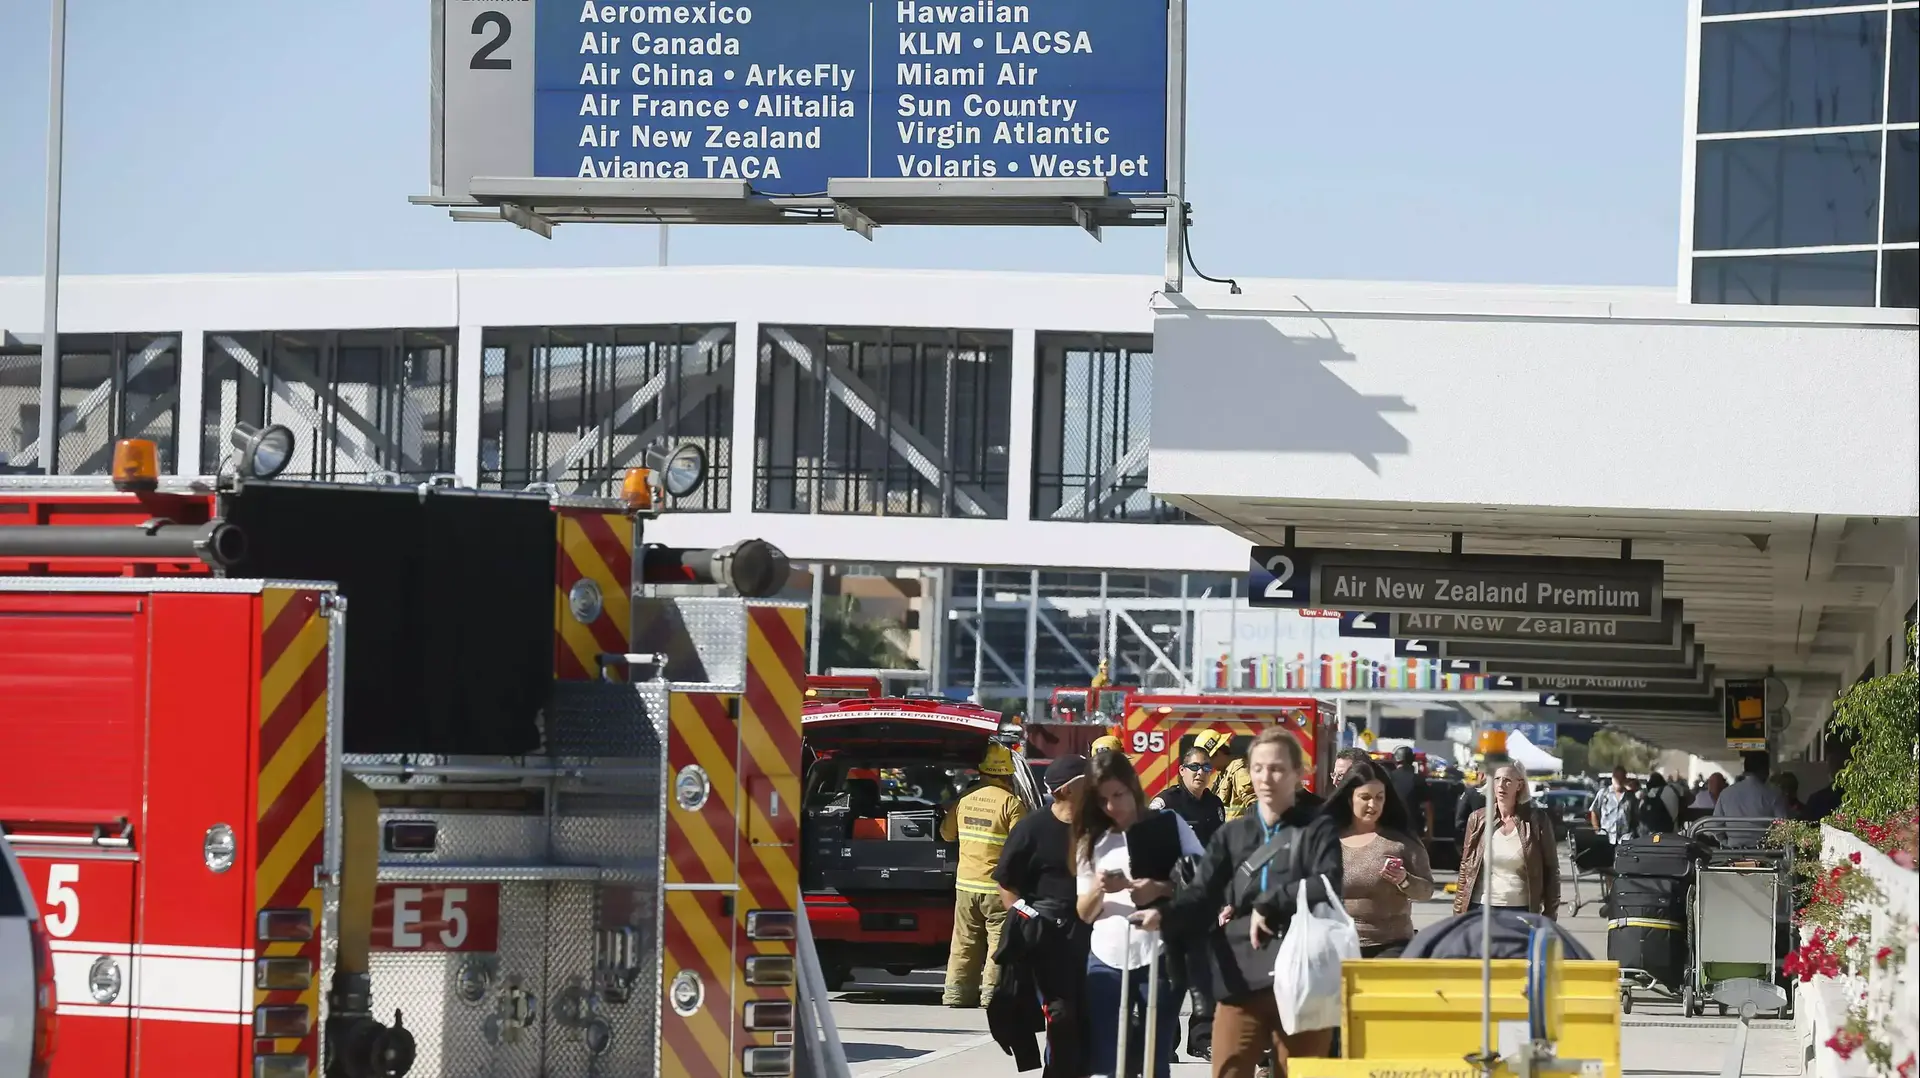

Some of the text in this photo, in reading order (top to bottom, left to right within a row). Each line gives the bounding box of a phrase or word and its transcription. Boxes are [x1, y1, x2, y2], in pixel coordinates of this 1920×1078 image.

[579, 0, 752, 25] Aeromexico
[897, 0, 1029, 24] Hawaiian
[469, 10, 512, 71] 2
[579, 31, 740, 56] Air Canada
[899, 30, 1093, 55] KLM LACSA
[579, 62, 855, 92] Air China ArkeFly
[897, 62, 1038, 86] Miami Air
[579, 93, 855, 118] Air France Alitalia
[897, 93, 1078, 122] Sun Country
[578, 124, 821, 149] Air New Zealand
[896, 121, 1110, 149] Virgin Atlantic
[577, 155, 781, 179] Avianca TACA
[896, 154, 1149, 178] Volaris WestJet
[1263, 555, 1295, 598] 2
[1333, 575, 1640, 607] Air New Zealand Premium
[1302, 608, 1317, 617] Tow
[1406, 613, 1617, 636] Air New Zealand
[900, 712, 969, 723] DEPARTMENT
[1133, 731, 1165, 753] 95
[44, 863, 80, 938] 5
[392, 887, 468, 949] E 5
